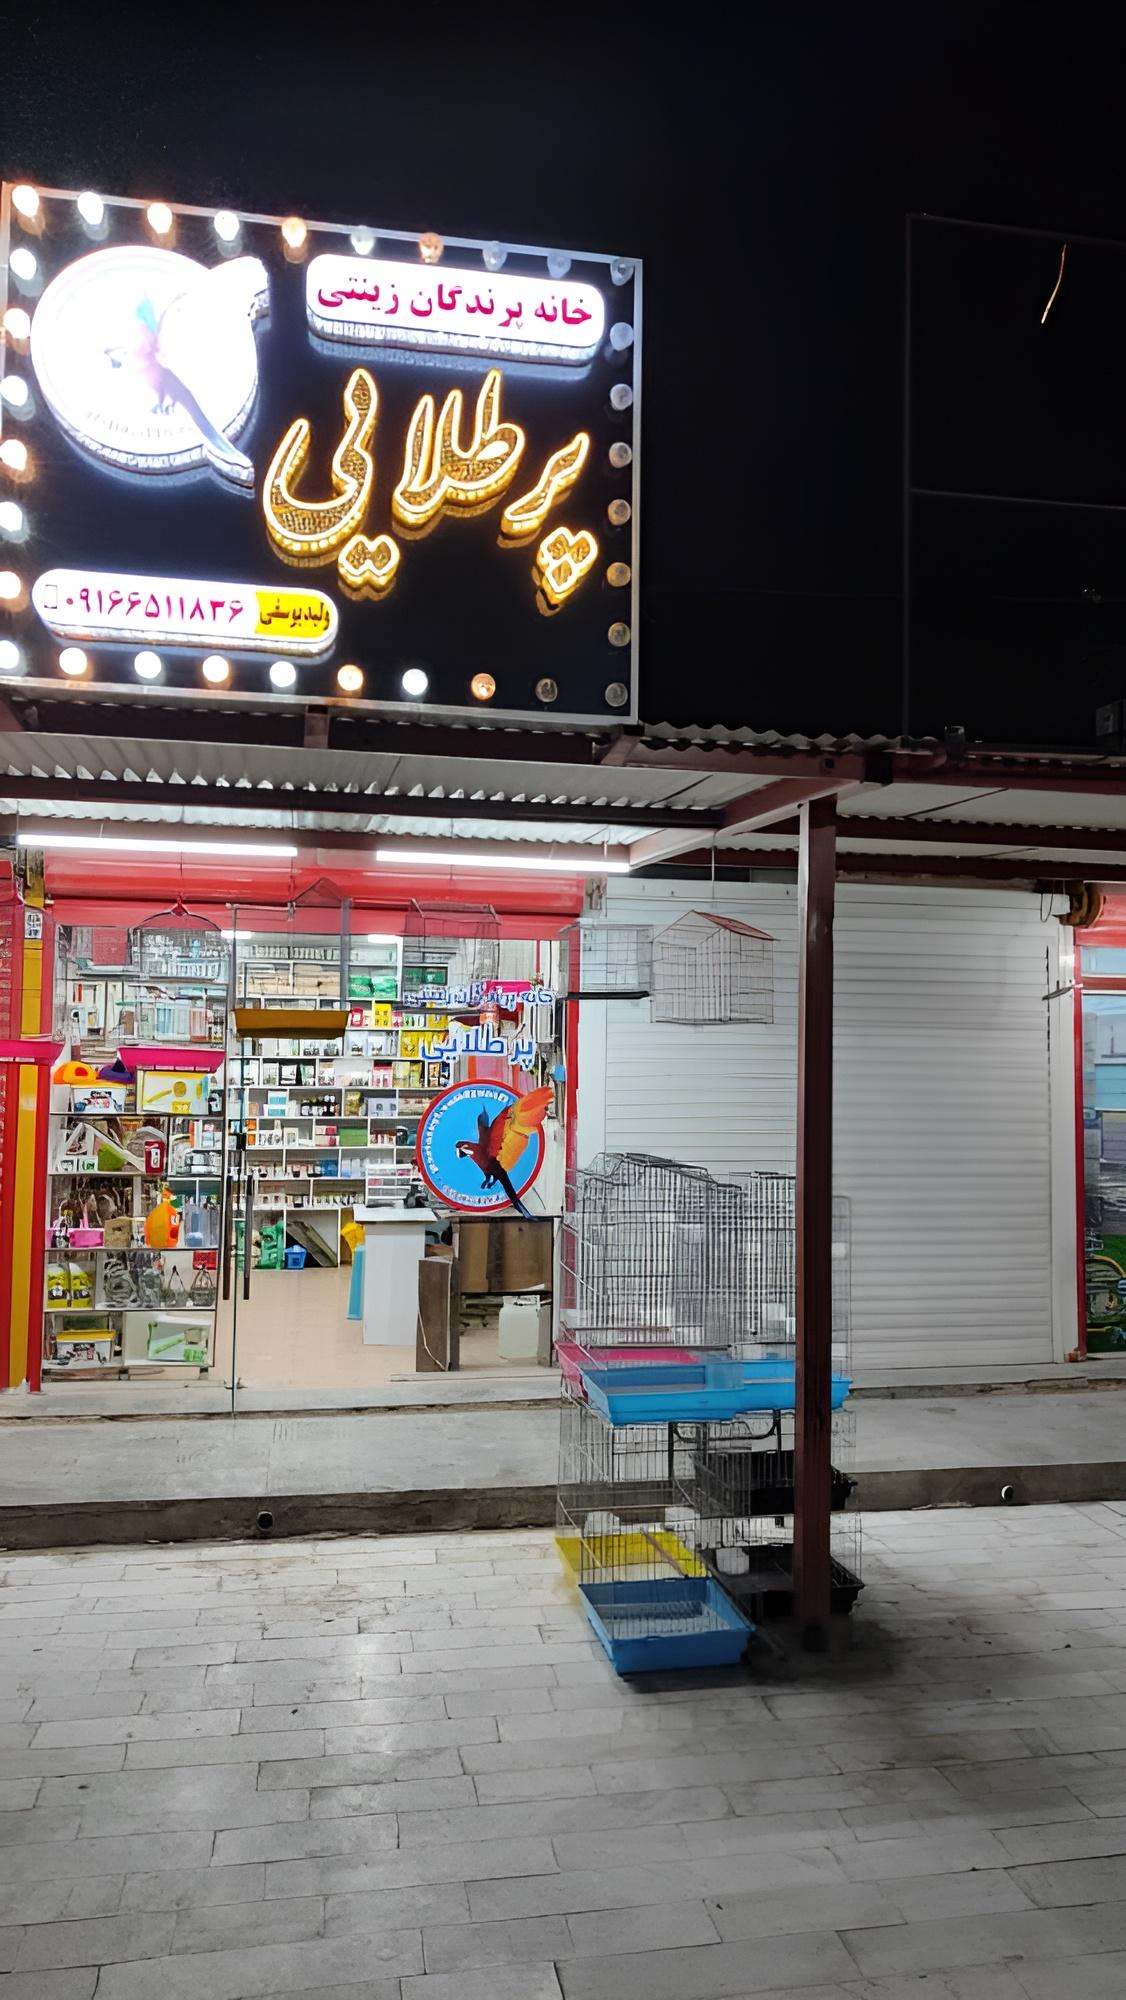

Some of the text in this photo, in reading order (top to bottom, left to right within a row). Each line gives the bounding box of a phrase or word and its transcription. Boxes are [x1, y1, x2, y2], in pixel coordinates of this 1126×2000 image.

[317, 277, 592, 329] خانه پرندگان زینتی
[66, 588, 243, 623] ۰۹۱۶۶۵۱۱۸۳۶
[421, 1023, 534, 1070] پر طلایی
